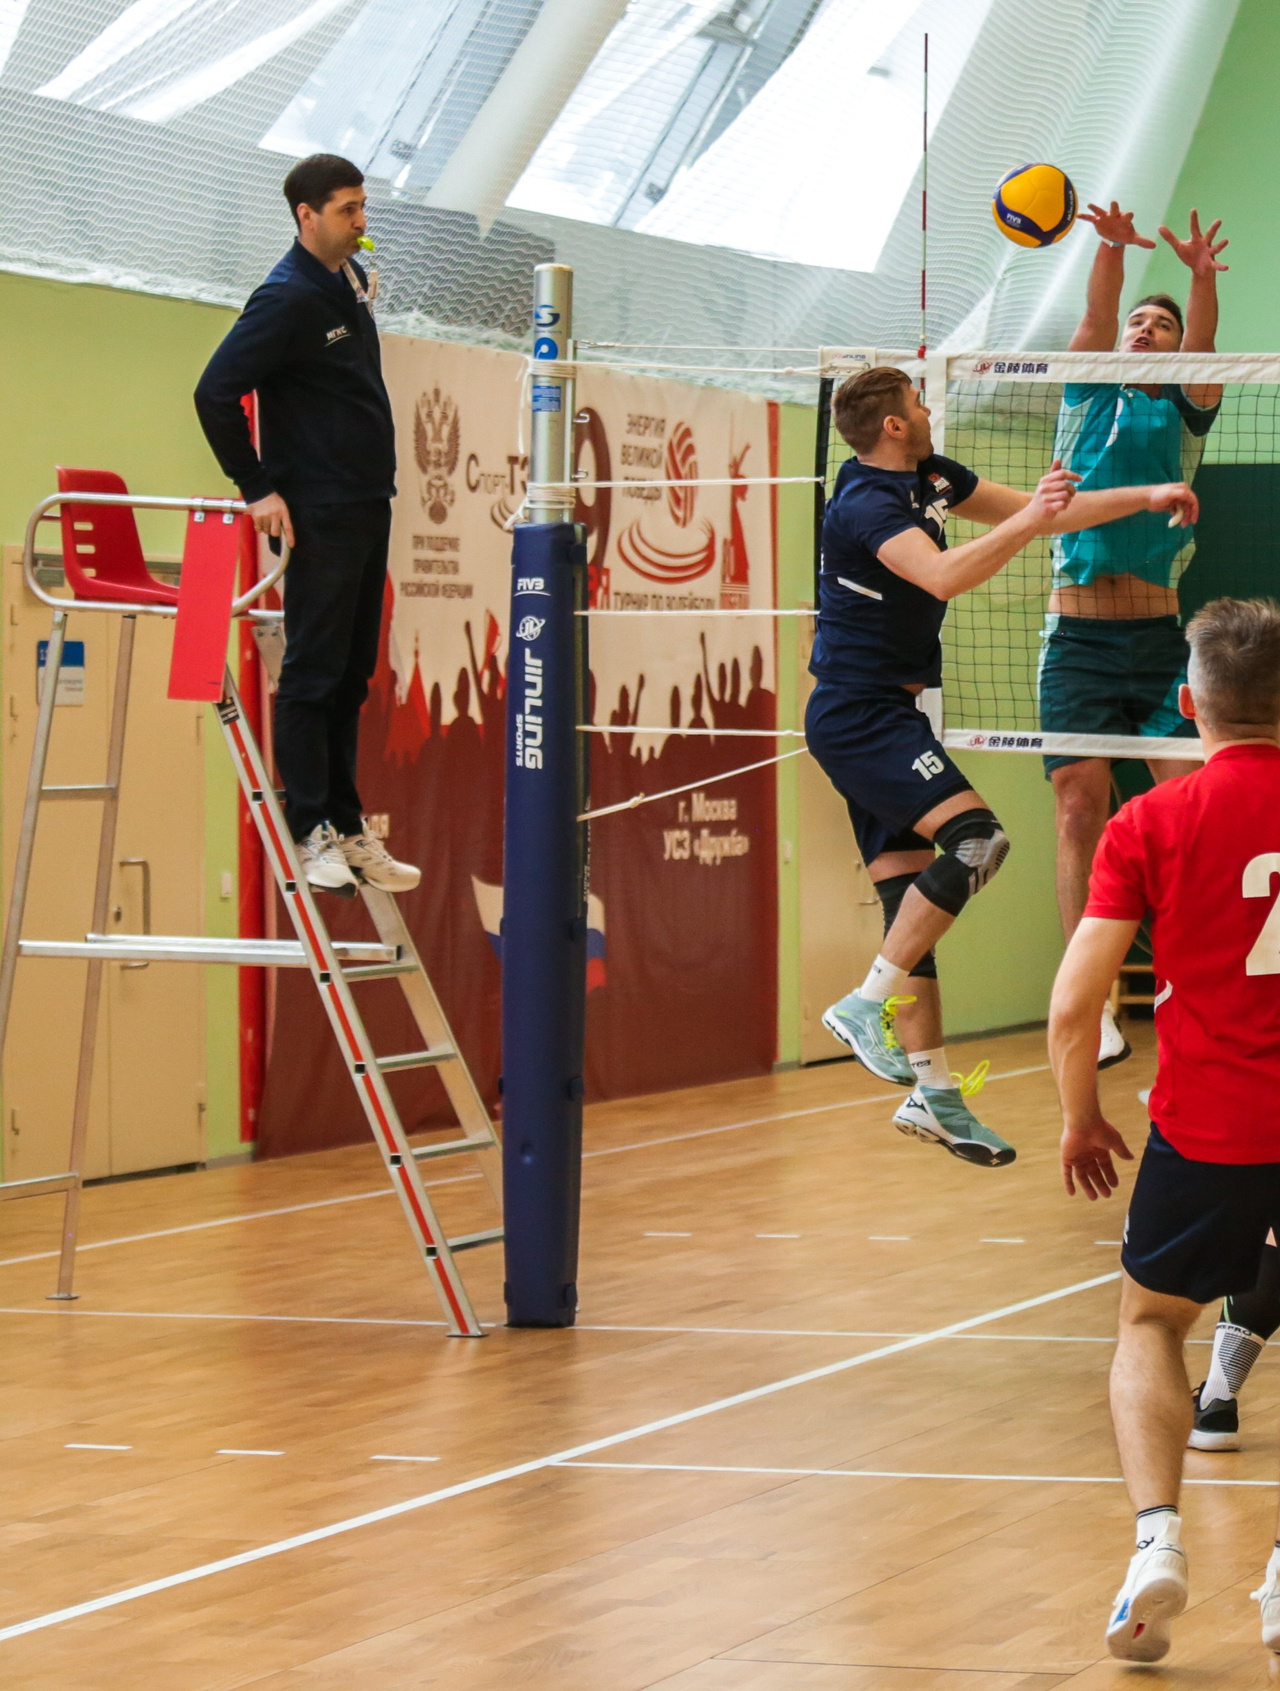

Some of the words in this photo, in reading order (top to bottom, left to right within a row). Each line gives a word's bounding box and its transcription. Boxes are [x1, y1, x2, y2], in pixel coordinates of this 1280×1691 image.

[994, 361, 1049, 374] 金陵体育
[517, 577, 545, 591] FIVB
[525, 647, 543, 770] JINLING
[516, 713, 524, 767] SPORTS
[988, 736, 1043, 748] 金陵体育
[911, 750, 945, 781] 15
